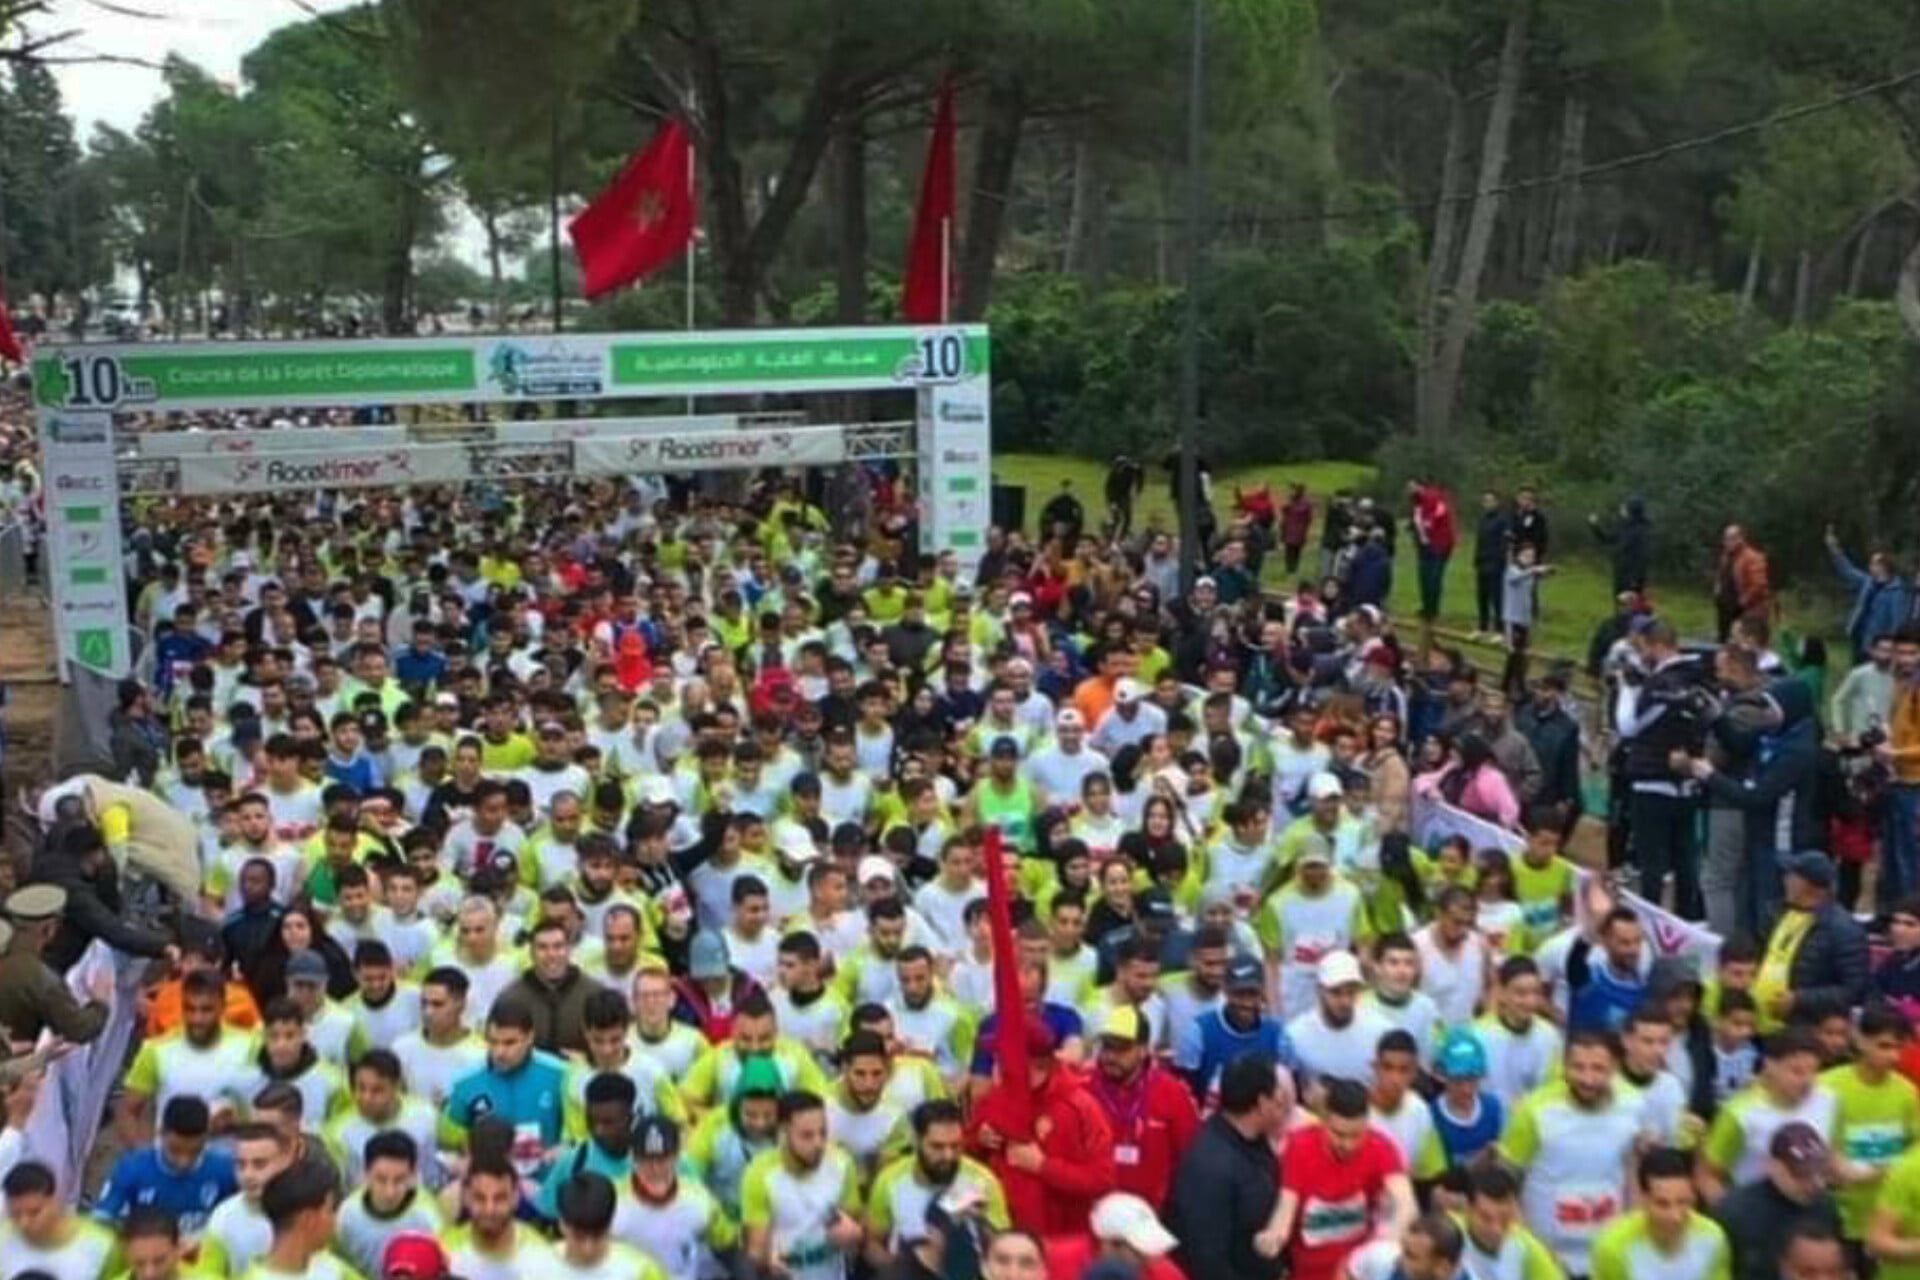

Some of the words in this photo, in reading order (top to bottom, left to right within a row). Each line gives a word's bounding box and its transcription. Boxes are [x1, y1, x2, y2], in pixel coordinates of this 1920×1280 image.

[921, 335, 961, 377] 10
[66, 355, 118, 404] 10
[169, 367, 233, 383] Course
[238, 366, 260, 382] de
[263, 364, 281, 381] la
[337, 361, 457, 383] Diplomatique
[657, 436, 762, 461] Racetimer
[266, 457, 381, 484] Racetimer
